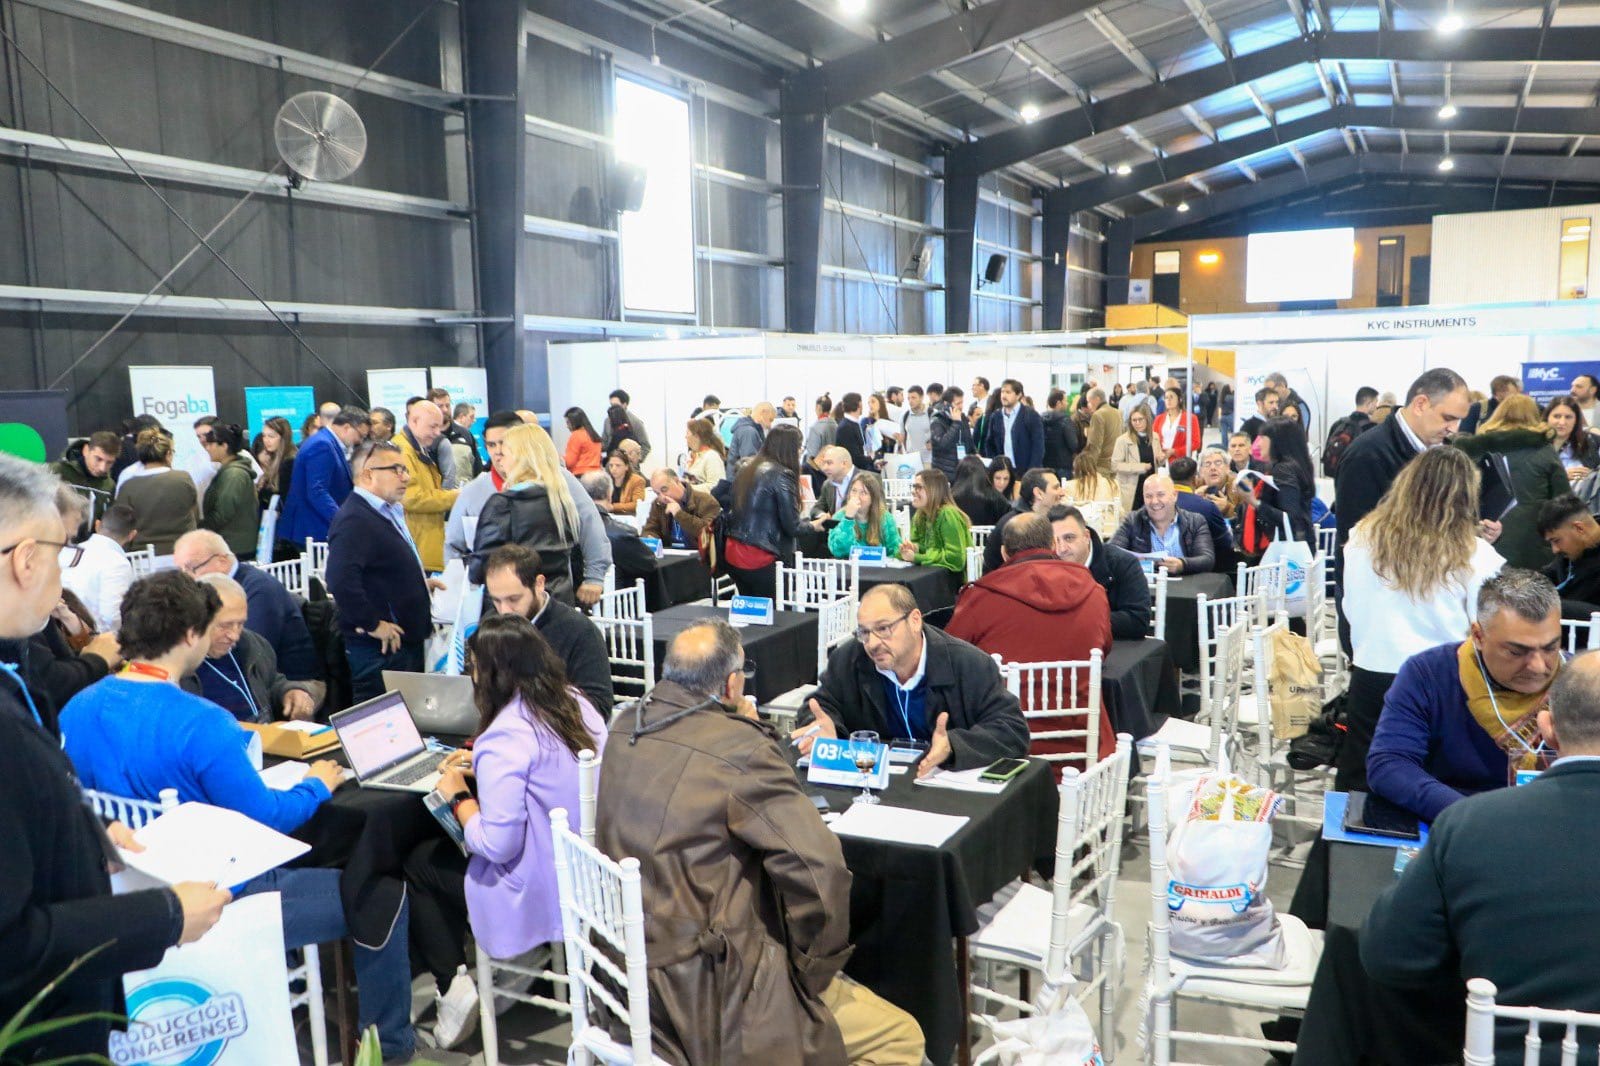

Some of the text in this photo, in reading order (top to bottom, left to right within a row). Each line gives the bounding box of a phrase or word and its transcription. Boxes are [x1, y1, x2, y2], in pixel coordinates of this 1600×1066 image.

[1367, 316, 1477, 330] KYC INSTRUMENTS
[143, 393, 209, 420] Fogaba
[733, 598, 746, 609] 09
[817, 743, 839, 761] 03
[1174, 885, 1242, 899] GRIMALDI
[111, 999, 236, 1047] RODUCCIÓN
[114, 1015, 241, 1063] ONAERENSE
